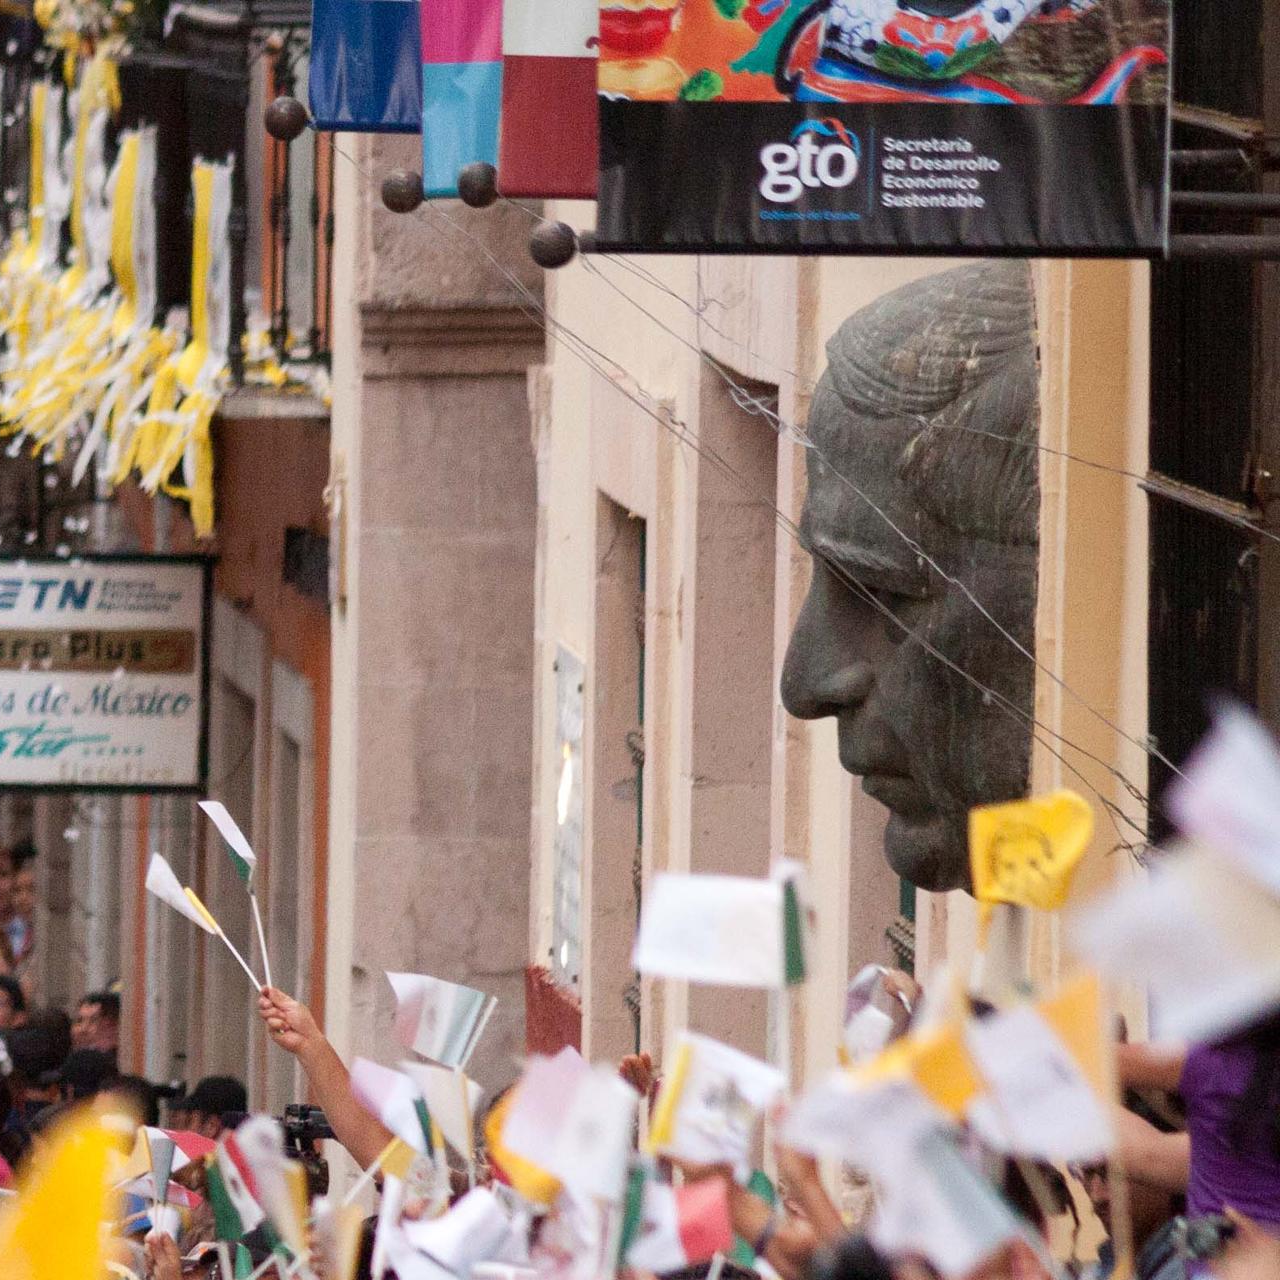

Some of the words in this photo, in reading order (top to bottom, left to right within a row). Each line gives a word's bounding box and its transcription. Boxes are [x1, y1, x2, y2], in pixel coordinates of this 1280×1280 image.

[759, 131, 859, 203] gto
[882, 155, 907, 171] de
[909, 155, 1001, 172] Desarrollo
[881, 173, 981, 190] Económico
[881, 192, 986, 209] Sustentable
[69, 630, 146, 661] Plus
[26, 681, 70, 715] de
